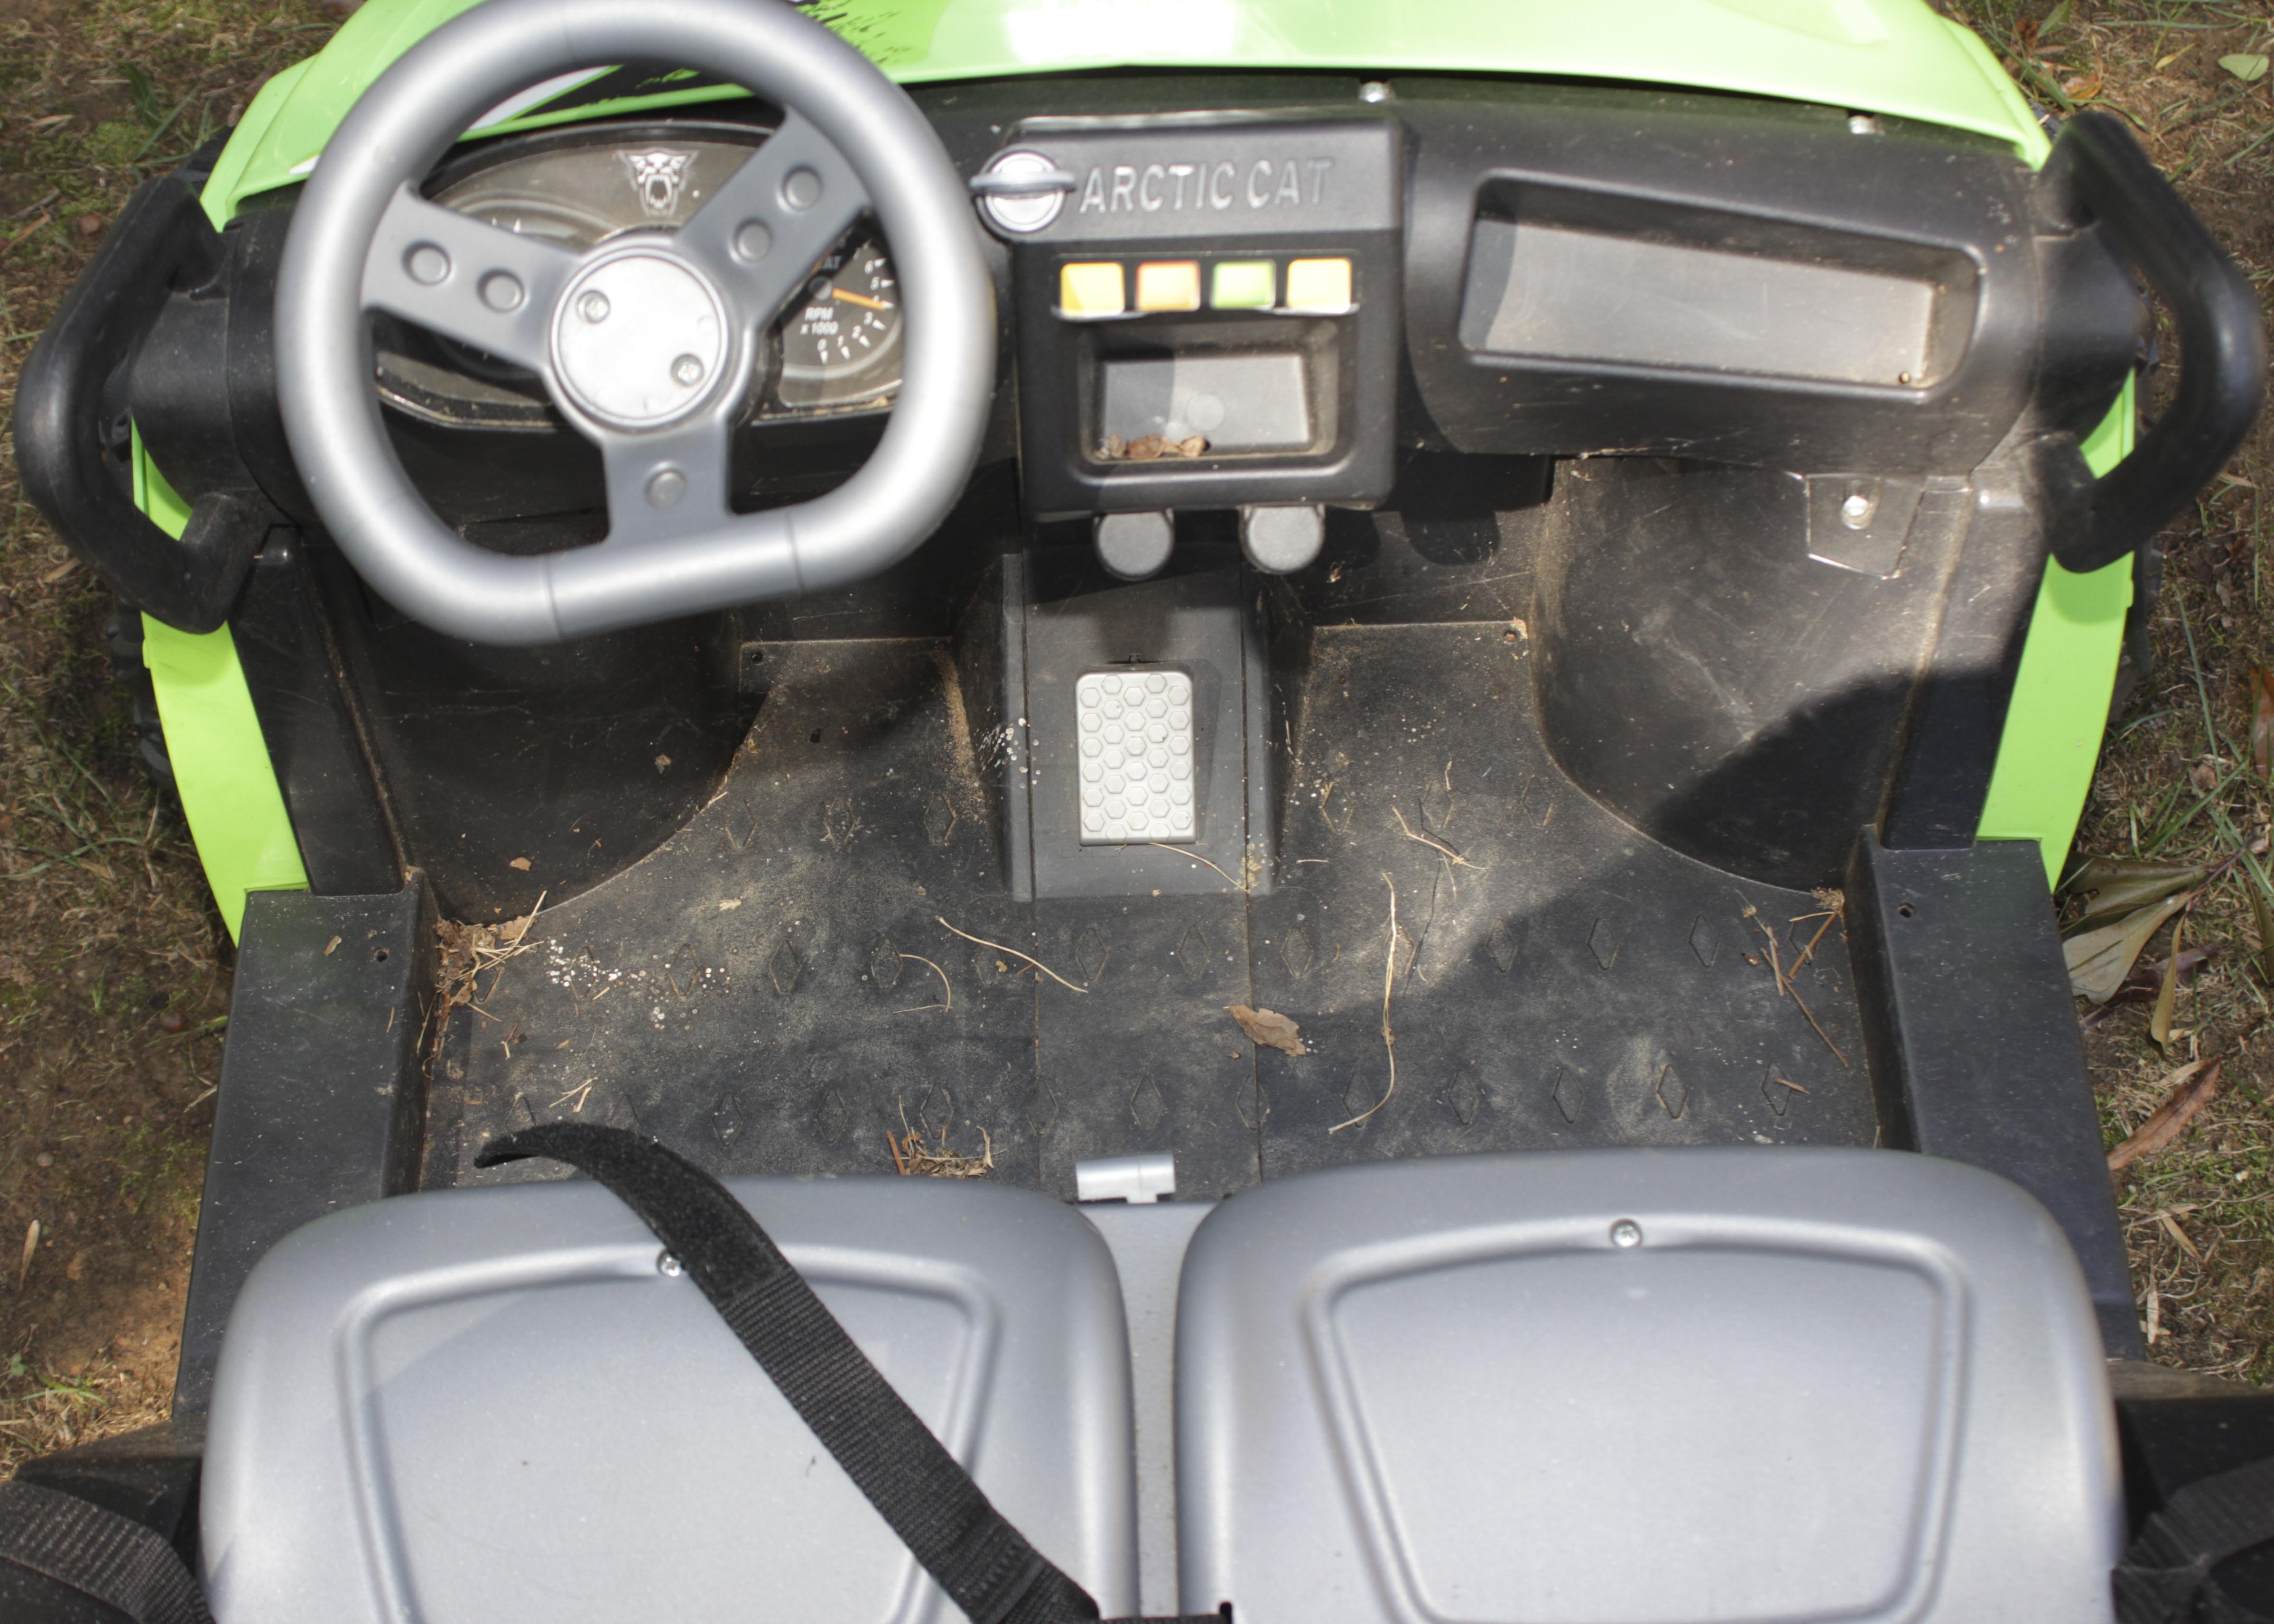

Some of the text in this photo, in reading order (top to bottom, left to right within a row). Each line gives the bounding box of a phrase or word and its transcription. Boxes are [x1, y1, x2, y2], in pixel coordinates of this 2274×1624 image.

[1079, 158, 1335, 214] ARCTIC CAT
[864, 260, 873, 275] 6
[870, 277, 880, 291] 5
[805, 306, 834, 321] RPM
[863, 311, 873, 325] 3
[811, 321, 839, 335] 1000
[852, 325, 862, 339] 2
[817, 338, 827, 351] 0
[837, 334, 844, 348] 1
